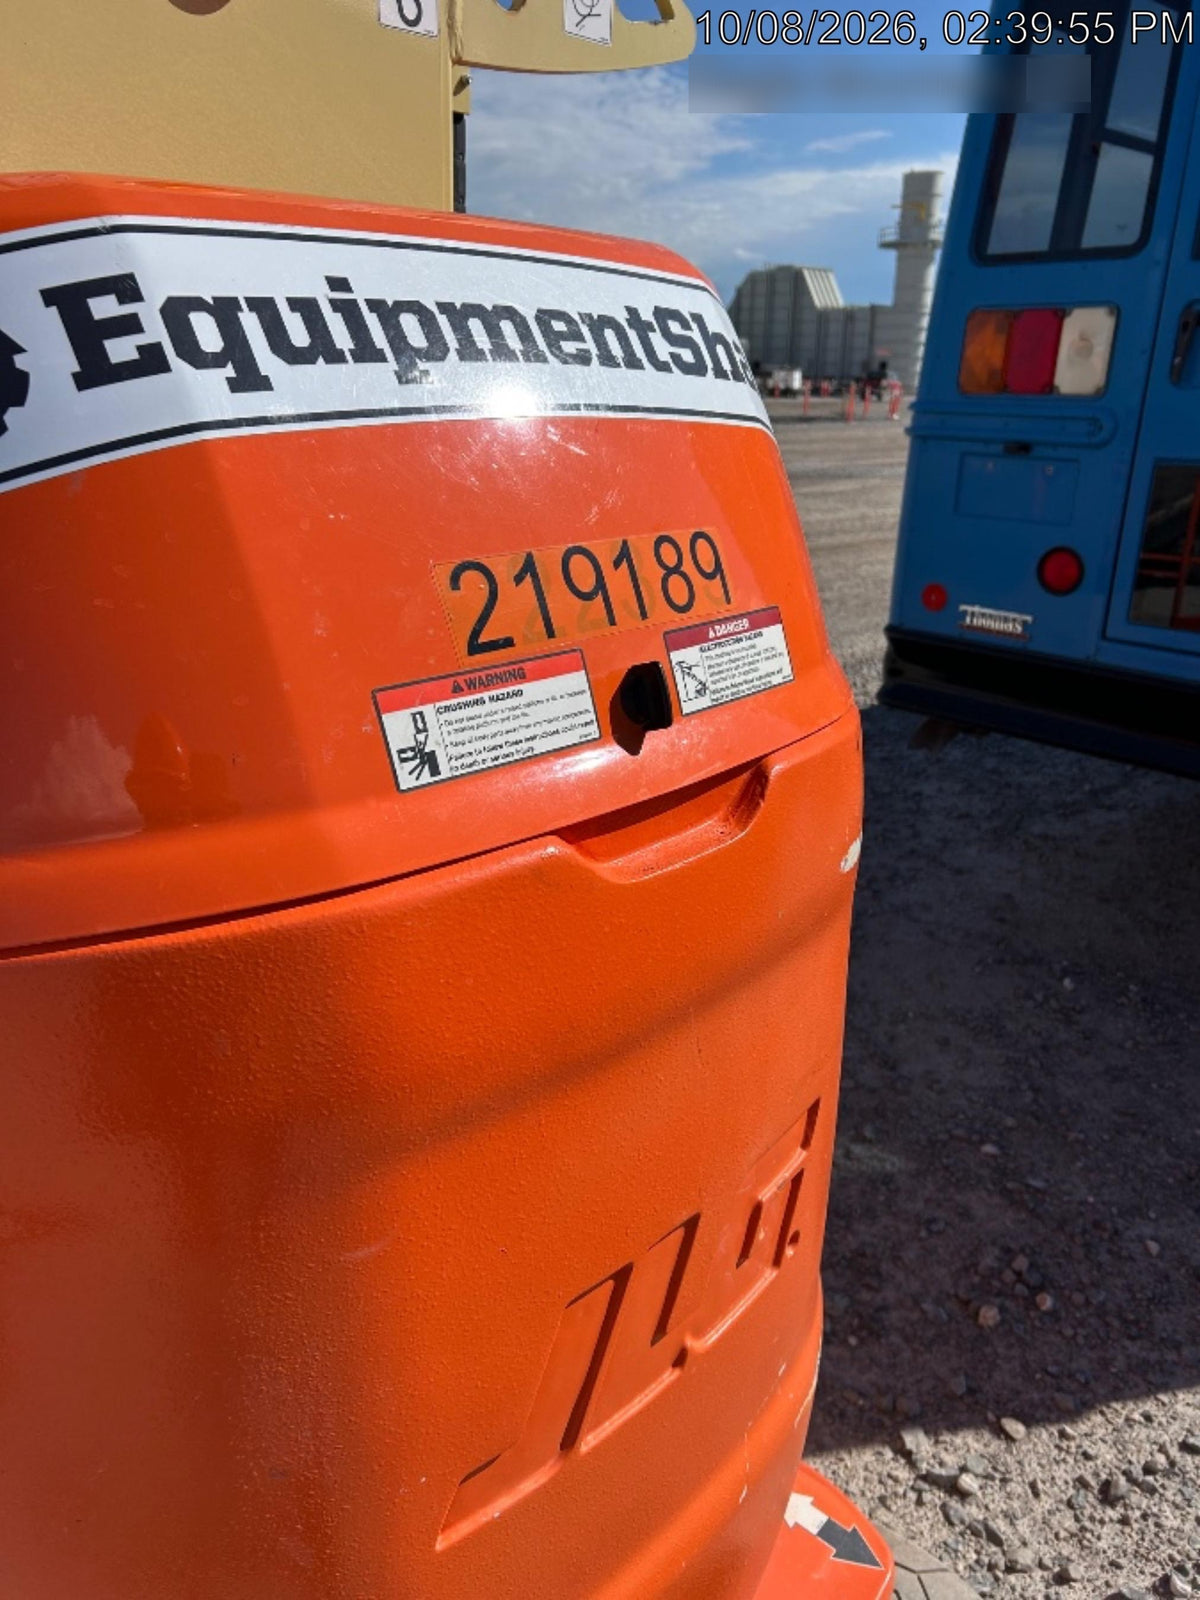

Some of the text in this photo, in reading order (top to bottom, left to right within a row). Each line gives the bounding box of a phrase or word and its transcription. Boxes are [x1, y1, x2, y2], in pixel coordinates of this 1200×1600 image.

[39, 272, 758, 393] EquipmentSh
[450, 531, 731, 656] 219189
[714, 618, 749, 636] DANGER
[464, 666, 527, 690] WARNING
[436, 695, 486, 715] CRUSHING
[488, 688, 524, 704] HAZARD
